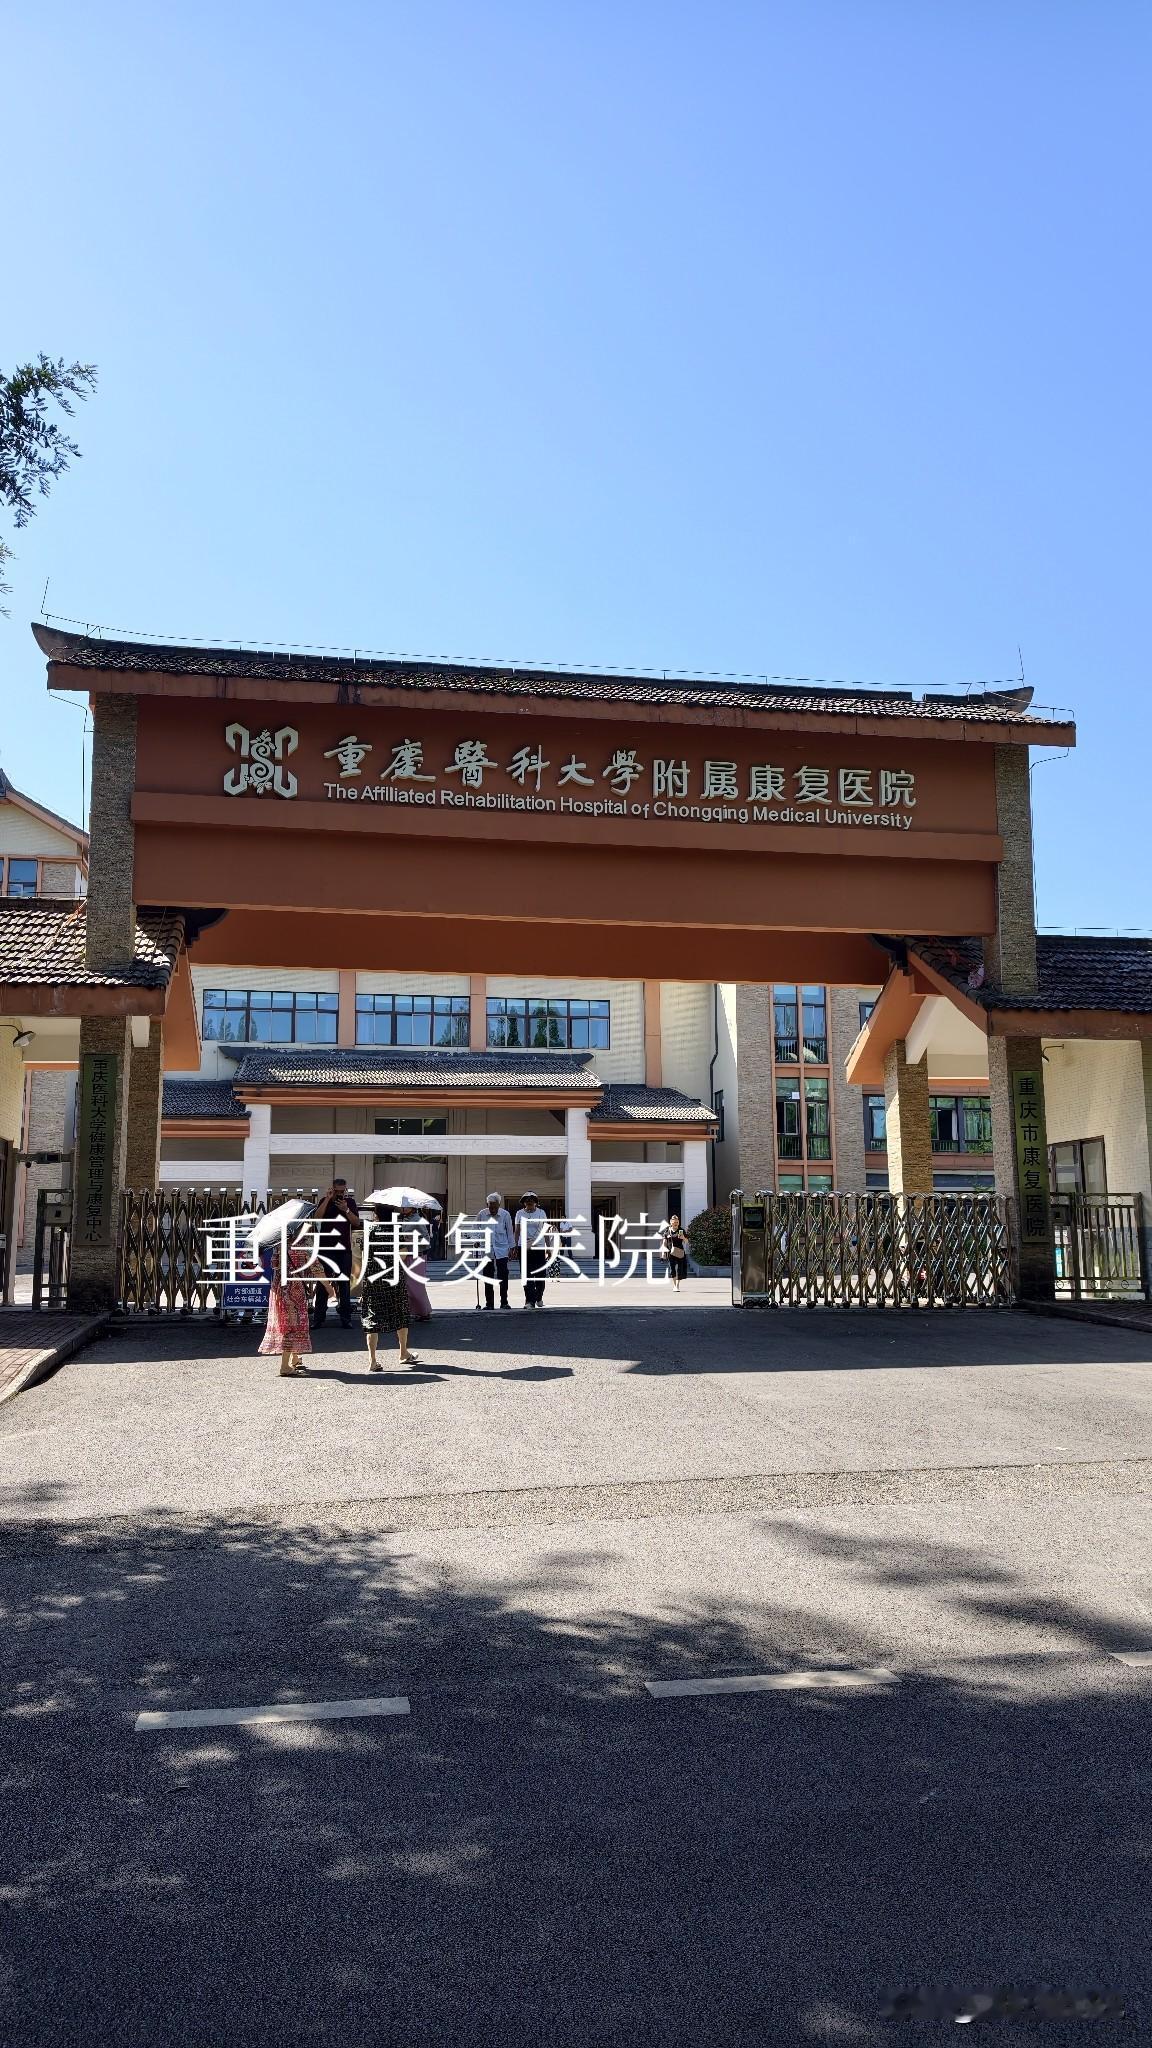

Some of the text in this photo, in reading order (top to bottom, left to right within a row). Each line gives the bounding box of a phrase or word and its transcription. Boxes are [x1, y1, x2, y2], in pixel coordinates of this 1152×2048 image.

[324, 782, 913, 830] The Affiliated Rehabilitation Hospital of Chongqing Medical University
[85, 1059, 110, 1242] 重庆医科大学健康管理与康复中心
[1018, 1077, 1045, 1237] 重庆市康复医院
